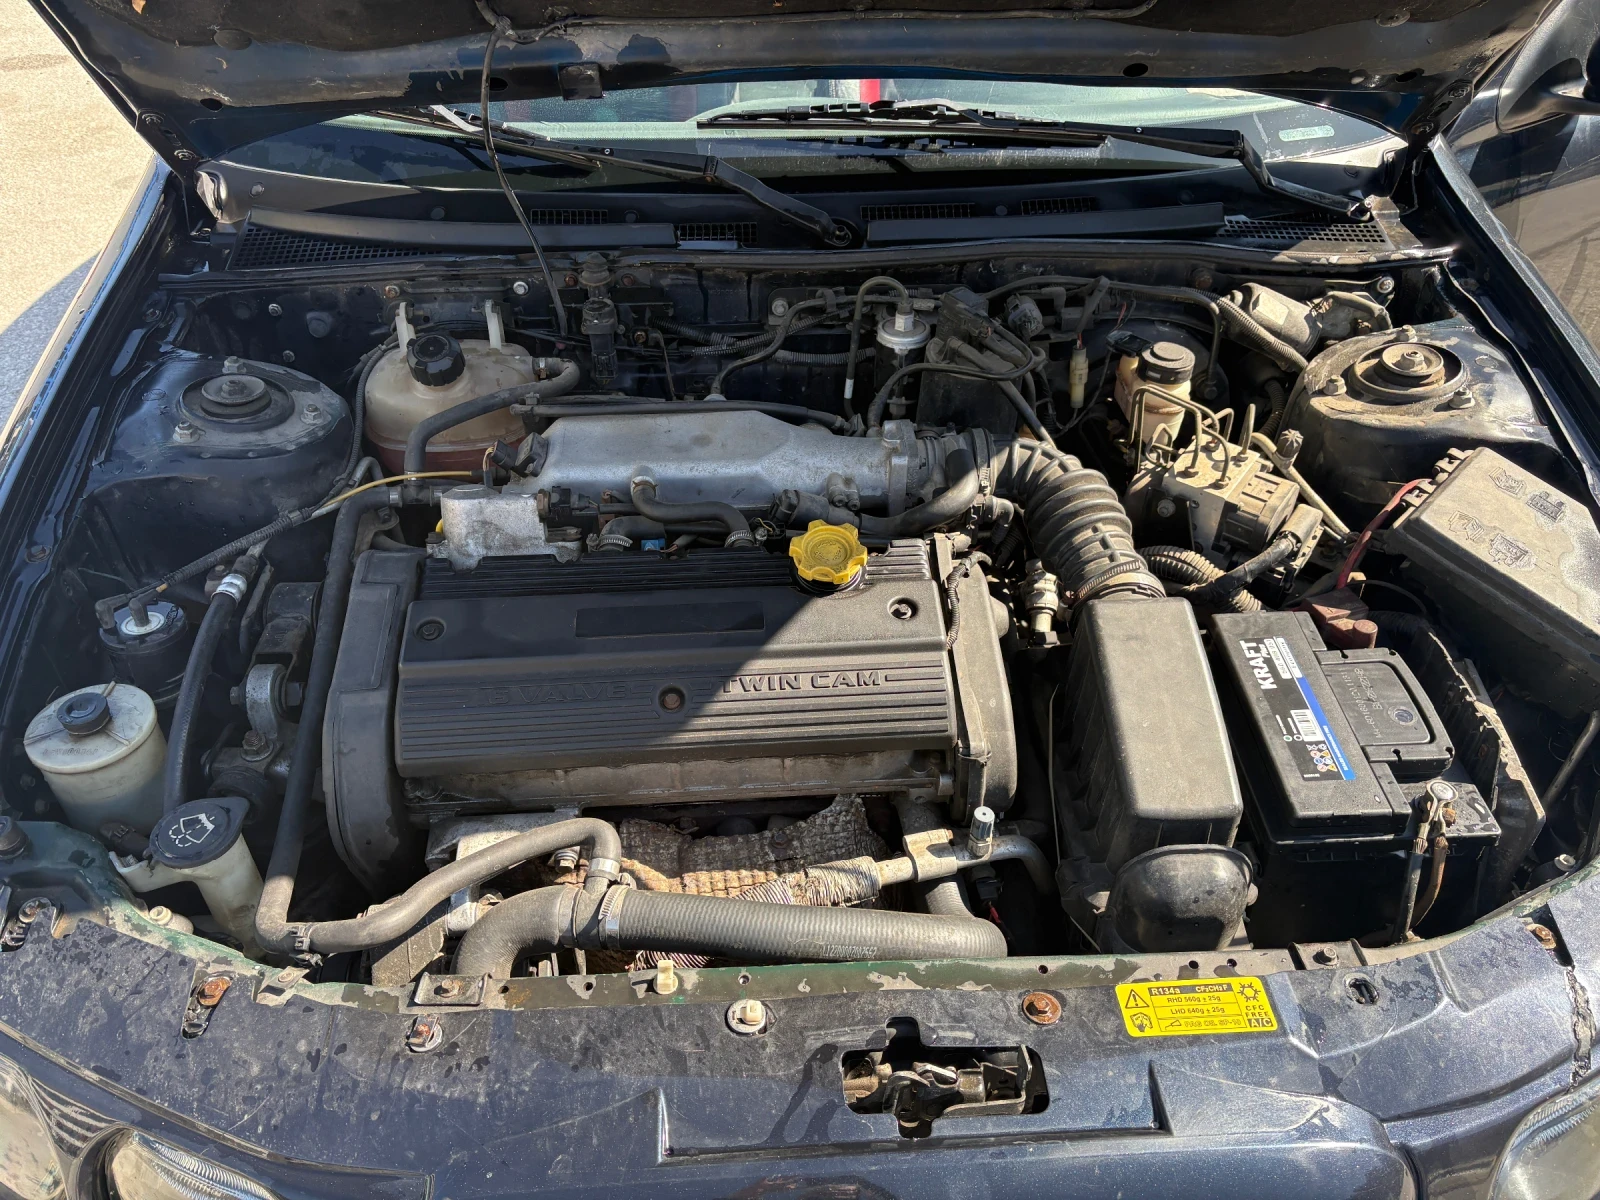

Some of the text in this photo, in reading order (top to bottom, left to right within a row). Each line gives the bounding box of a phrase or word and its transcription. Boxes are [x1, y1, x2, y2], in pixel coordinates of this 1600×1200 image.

[1239, 640, 1278, 689] KRAFT
[518, 682, 627, 703] VALVE
[718, 673, 802, 693] TWIN
[811, 670, 881, 689] CAM
[1151, 986, 1181, 996] R134a
[1251, 1018, 1273, 1027] A/C
